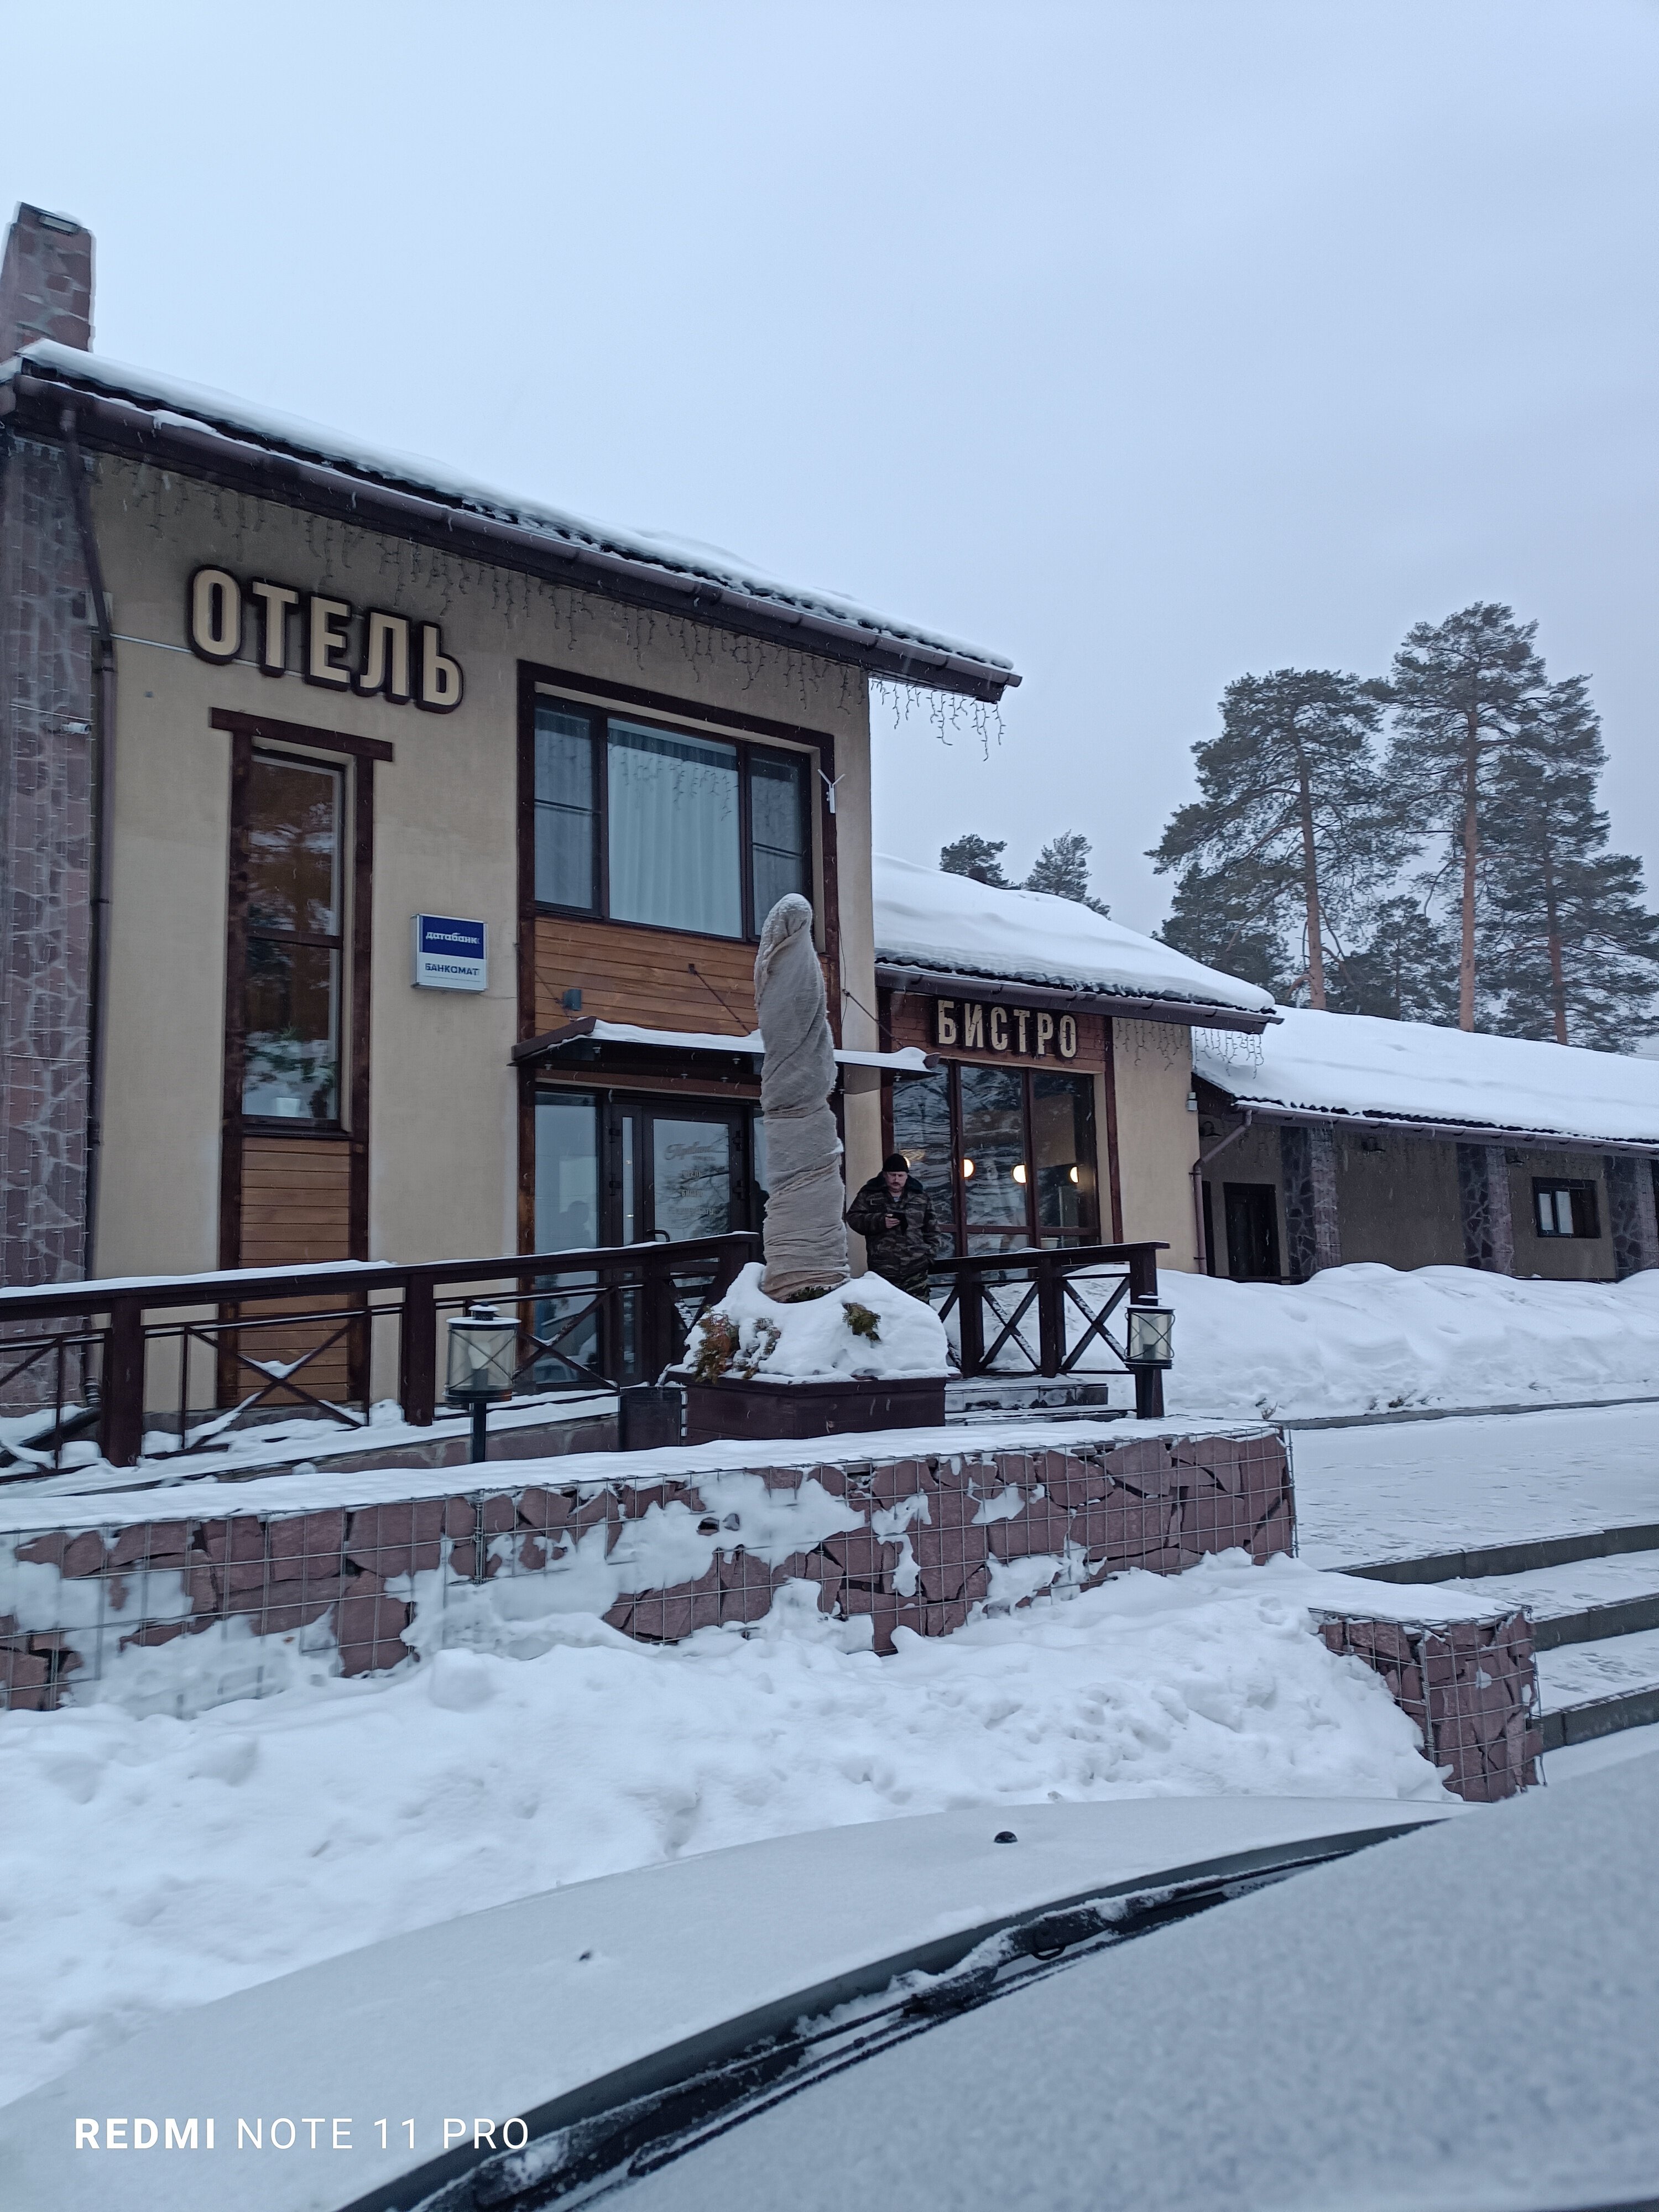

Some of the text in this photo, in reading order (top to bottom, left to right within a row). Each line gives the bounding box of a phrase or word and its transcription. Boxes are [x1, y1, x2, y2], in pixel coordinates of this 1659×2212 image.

[189, 566, 465, 710] ОТЕЛЬ
[426, 932, 479, 944] датабанк
[425, 963, 479, 975] БАНКОМАТ
[937, 999, 1077, 1058] БИСТРО
